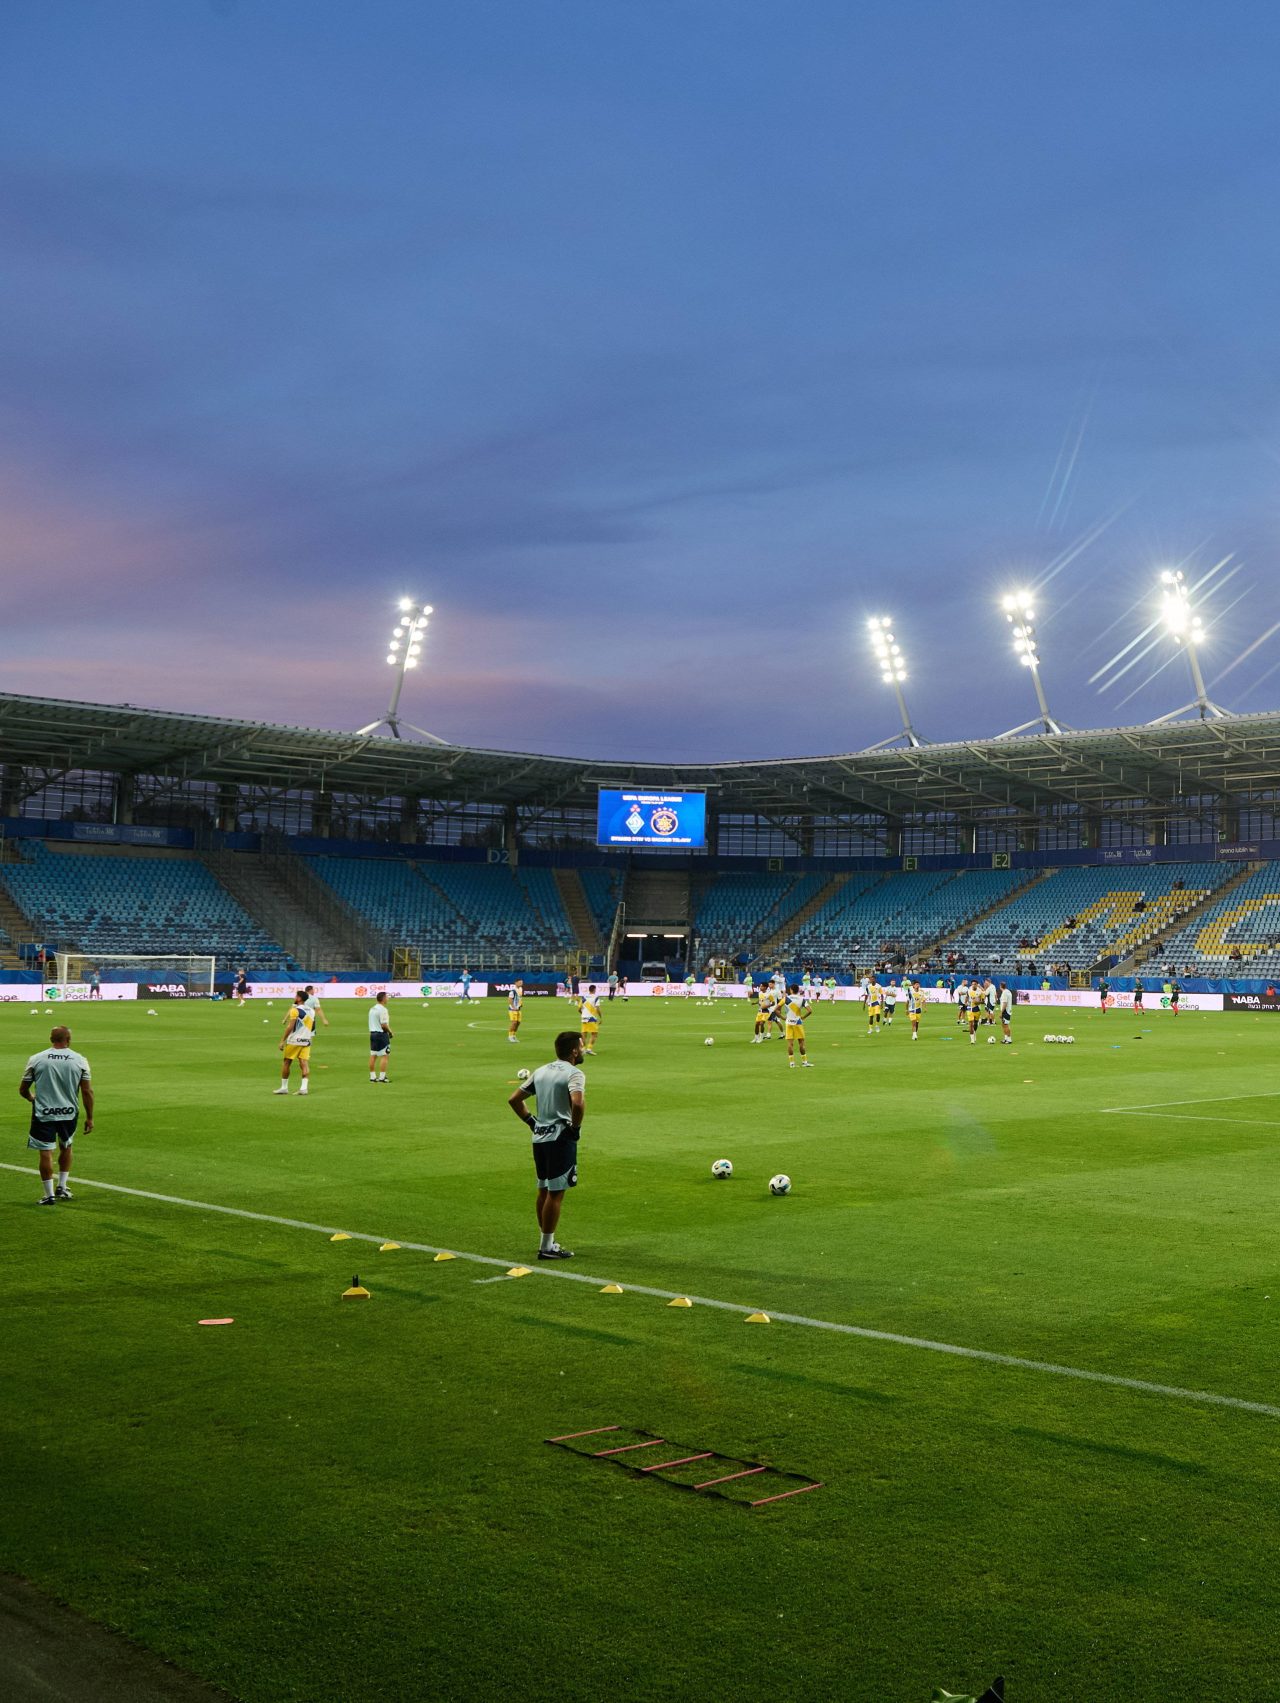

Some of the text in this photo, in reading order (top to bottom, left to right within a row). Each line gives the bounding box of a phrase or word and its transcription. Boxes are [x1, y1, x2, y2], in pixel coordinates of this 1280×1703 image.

[995, 853, 1008, 868] E2
[147, 984, 186, 992] NABA
[1231, 995, 1260, 1003] NABA
[1178, 1002, 1200, 1010] acking
[42, 1106, 75, 1116] CARGO
